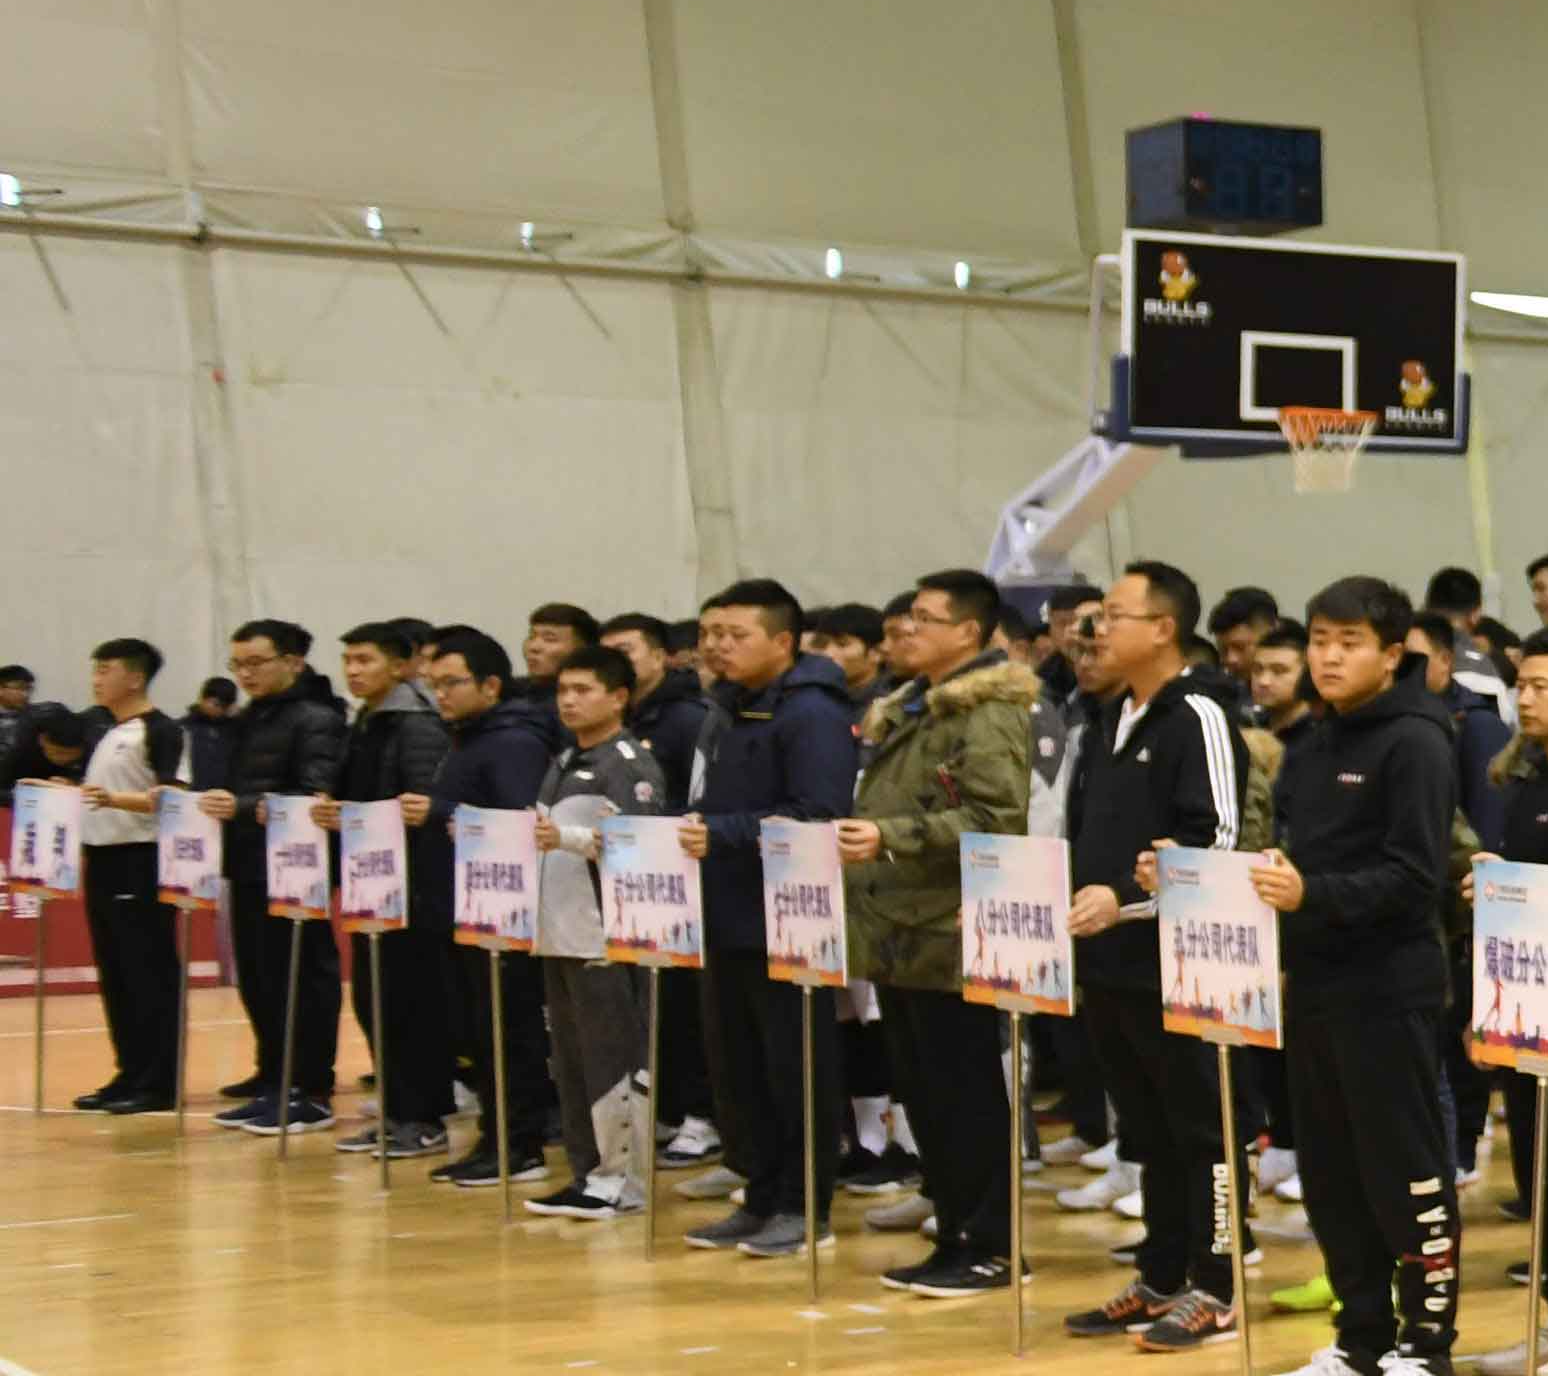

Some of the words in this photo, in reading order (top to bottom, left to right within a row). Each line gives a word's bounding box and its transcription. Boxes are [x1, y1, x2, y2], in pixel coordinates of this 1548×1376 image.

[975, 897, 1056, 944] 八分公司代表队
